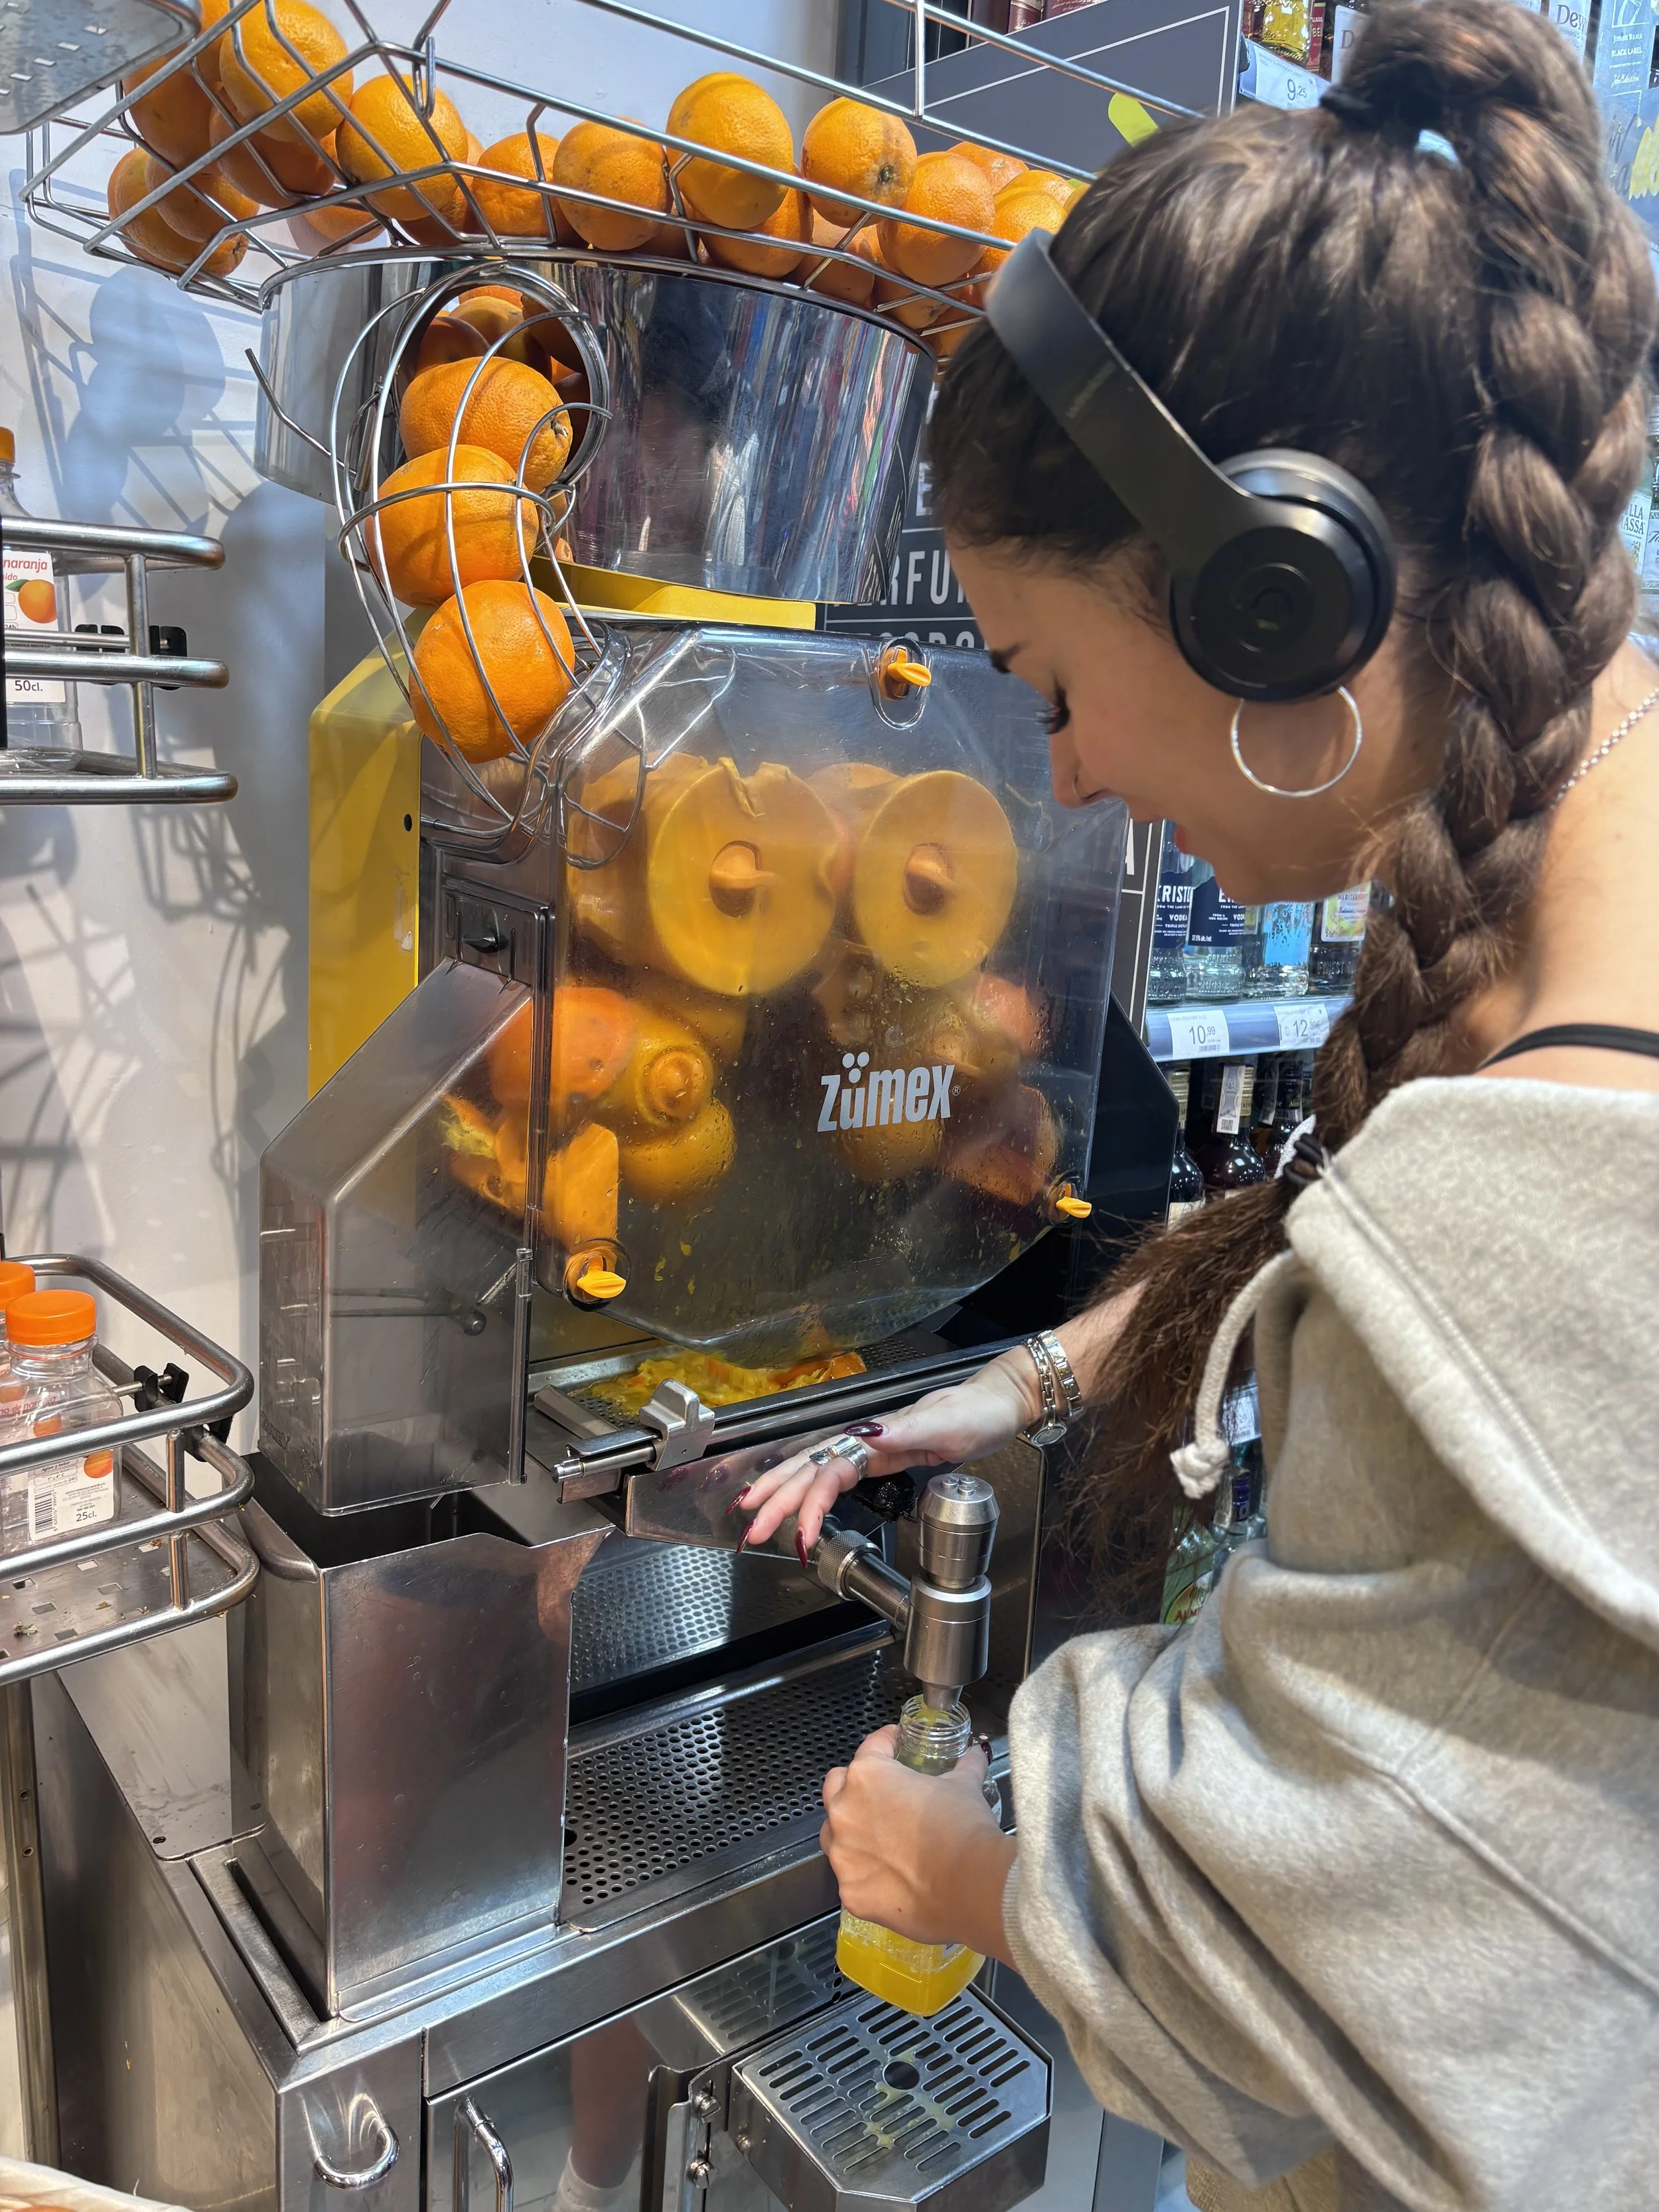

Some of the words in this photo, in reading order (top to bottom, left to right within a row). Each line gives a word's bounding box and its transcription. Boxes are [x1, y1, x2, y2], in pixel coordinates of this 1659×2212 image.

[1621, 517, 1644, 535] ASSA
[3, 559, 48, 573] naranja
[15, 680, 43, 692] 50cl.
[23, 1395, 56, 1409] narja
[76, 1511, 98, 1522] 25cl.
